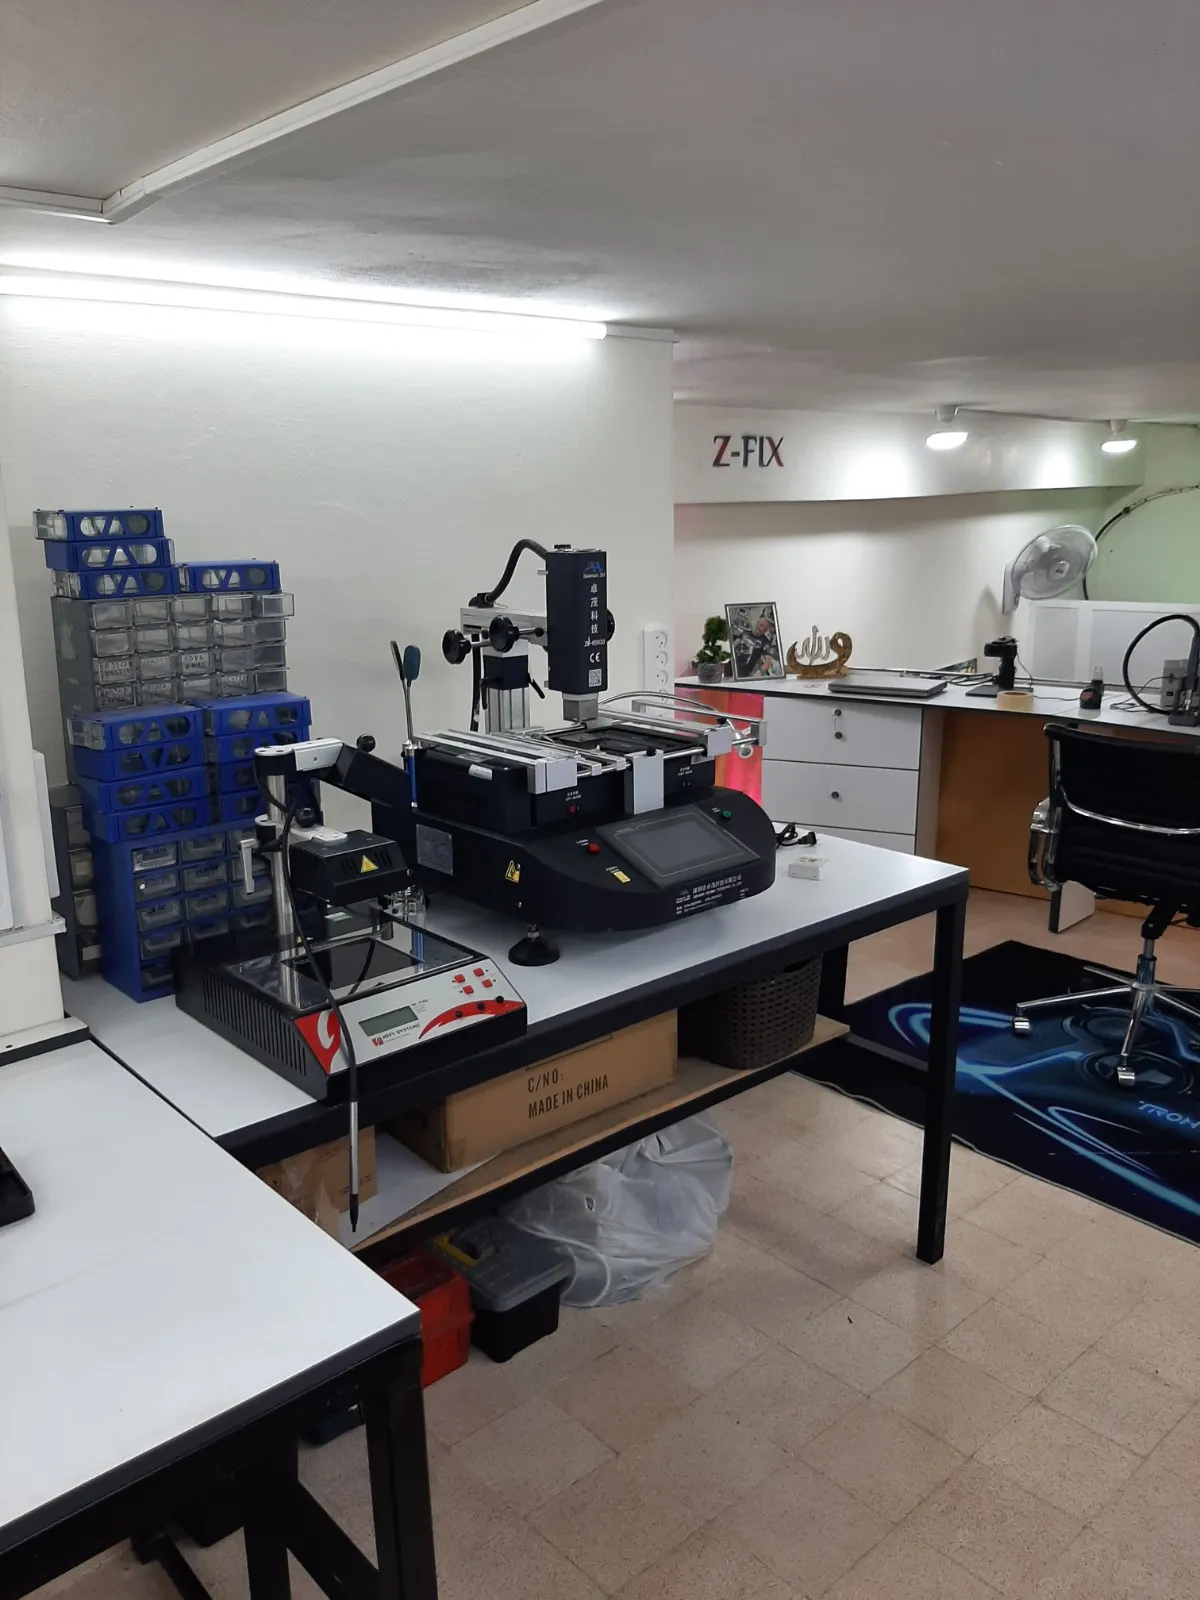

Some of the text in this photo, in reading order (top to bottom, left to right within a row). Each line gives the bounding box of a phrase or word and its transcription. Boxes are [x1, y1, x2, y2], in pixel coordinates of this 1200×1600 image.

[712, 434, 784, 468] Z-FIX
[590, 583, 599, 634] 卓茂科技
[589, 652, 600, 663] CE
[528, 1074, 609, 1119] MADE IN CHINA
